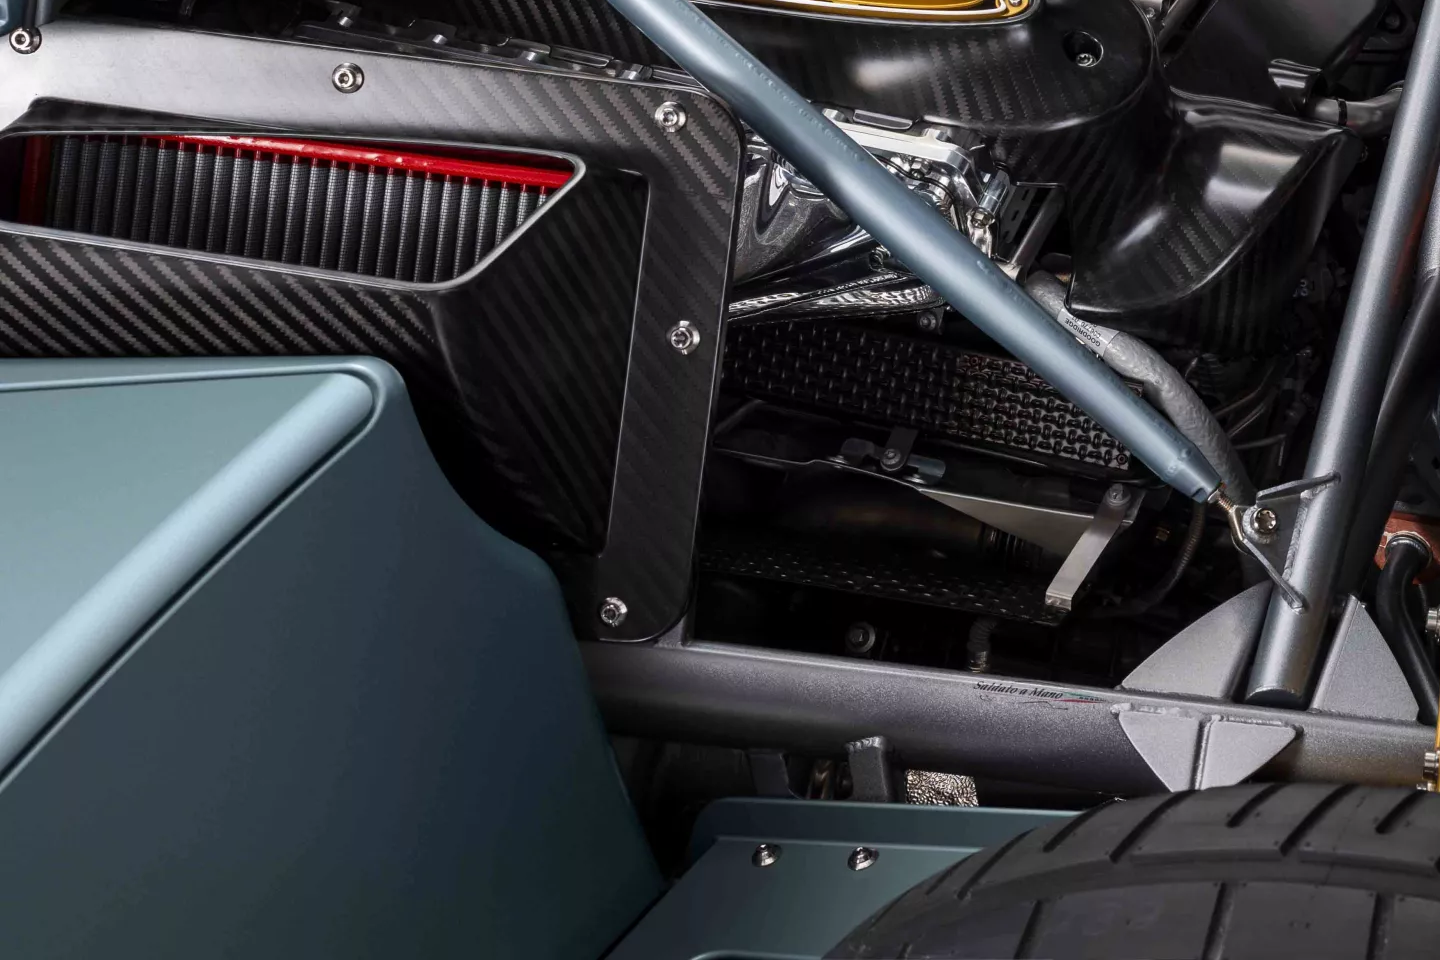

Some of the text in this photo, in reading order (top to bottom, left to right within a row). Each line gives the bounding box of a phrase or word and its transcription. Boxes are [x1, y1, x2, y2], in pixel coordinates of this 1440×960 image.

[1065, 317, 1101, 347] GOODRIDGE
[973, 680, 1018, 695] Saldato
[1019, 687, 1029, 696] a
[1028, 687, 1064, 699] Mano
